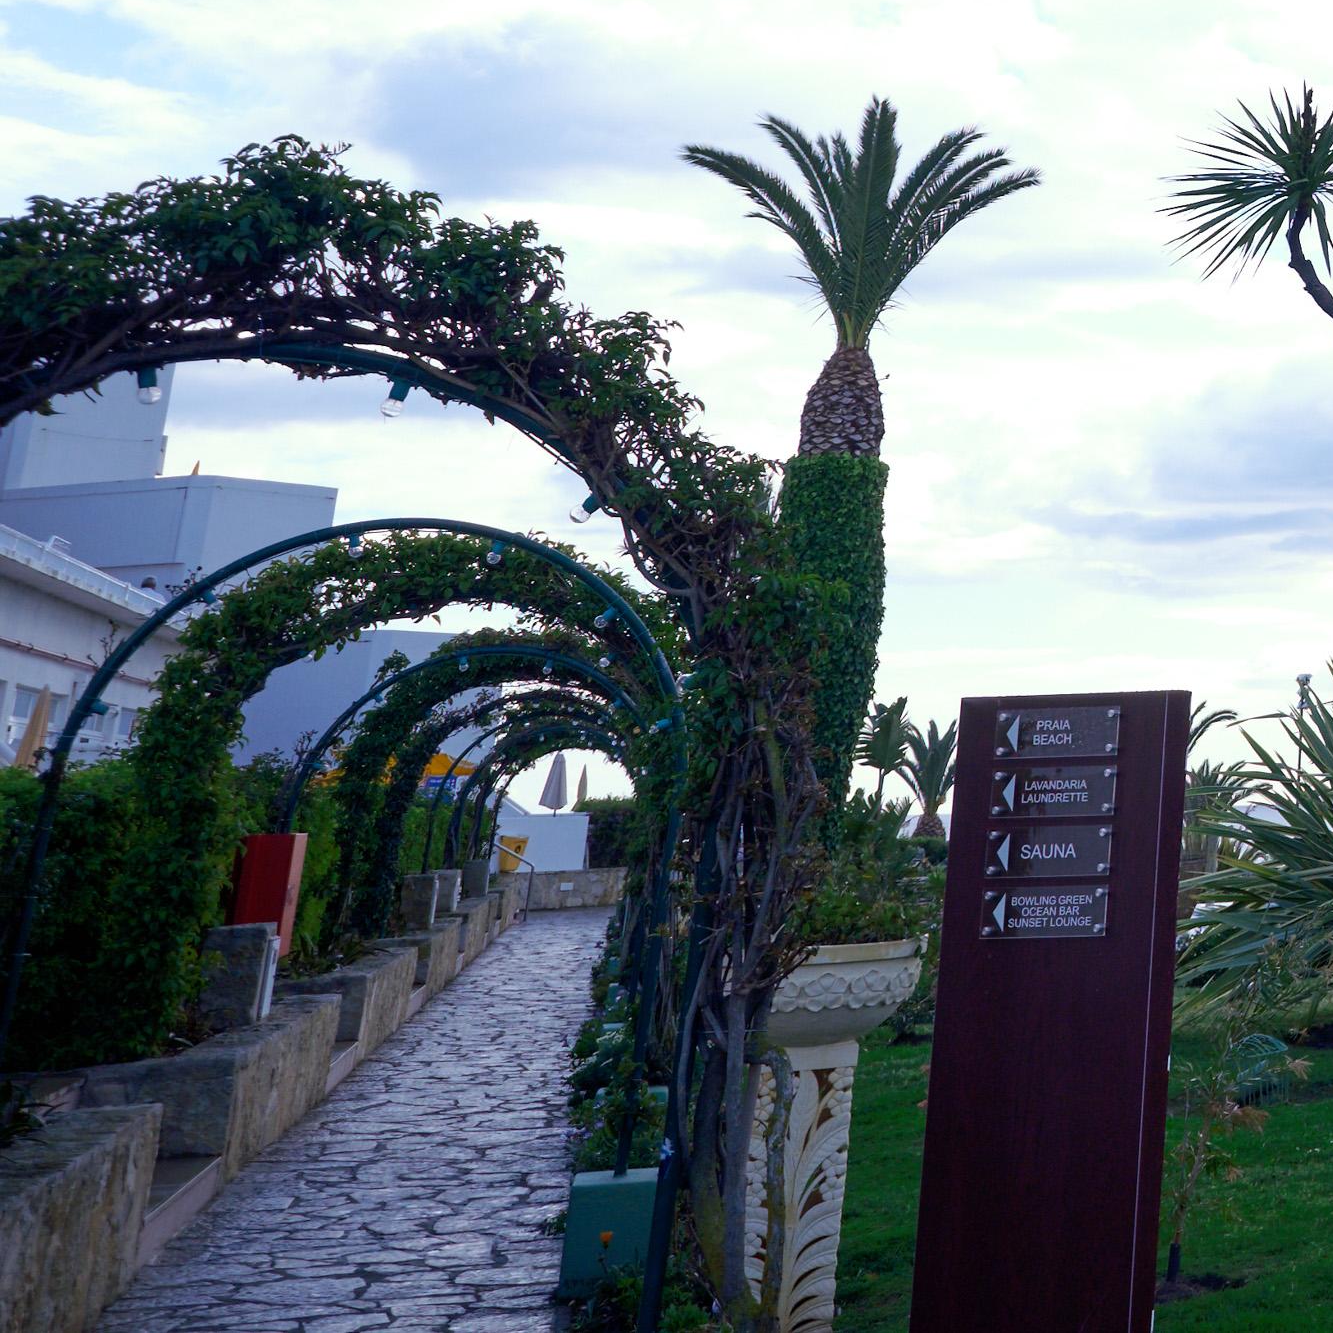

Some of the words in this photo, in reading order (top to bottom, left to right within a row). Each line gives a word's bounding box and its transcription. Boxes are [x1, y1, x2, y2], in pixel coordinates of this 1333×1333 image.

[1036, 719, 1071, 731] PRAIA
[1033, 733, 1072, 745] BEACH
[1024, 779, 1088, 791] LAVANDARIA
[1021, 792, 1089, 804] LAUNDRETTE
[1020, 842, 1077, 859] SAUNA
[1011, 896, 1057, 906] BOWLING
[1058, 894, 1093, 905] GREEN
[1021, 906, 1057, 917] OCEAN
[1059, 905, 1080, 916] BAR
[1008, 917, 1048, 928] SUNSET
[1050, 916, 1092, 927] LOUNGE
